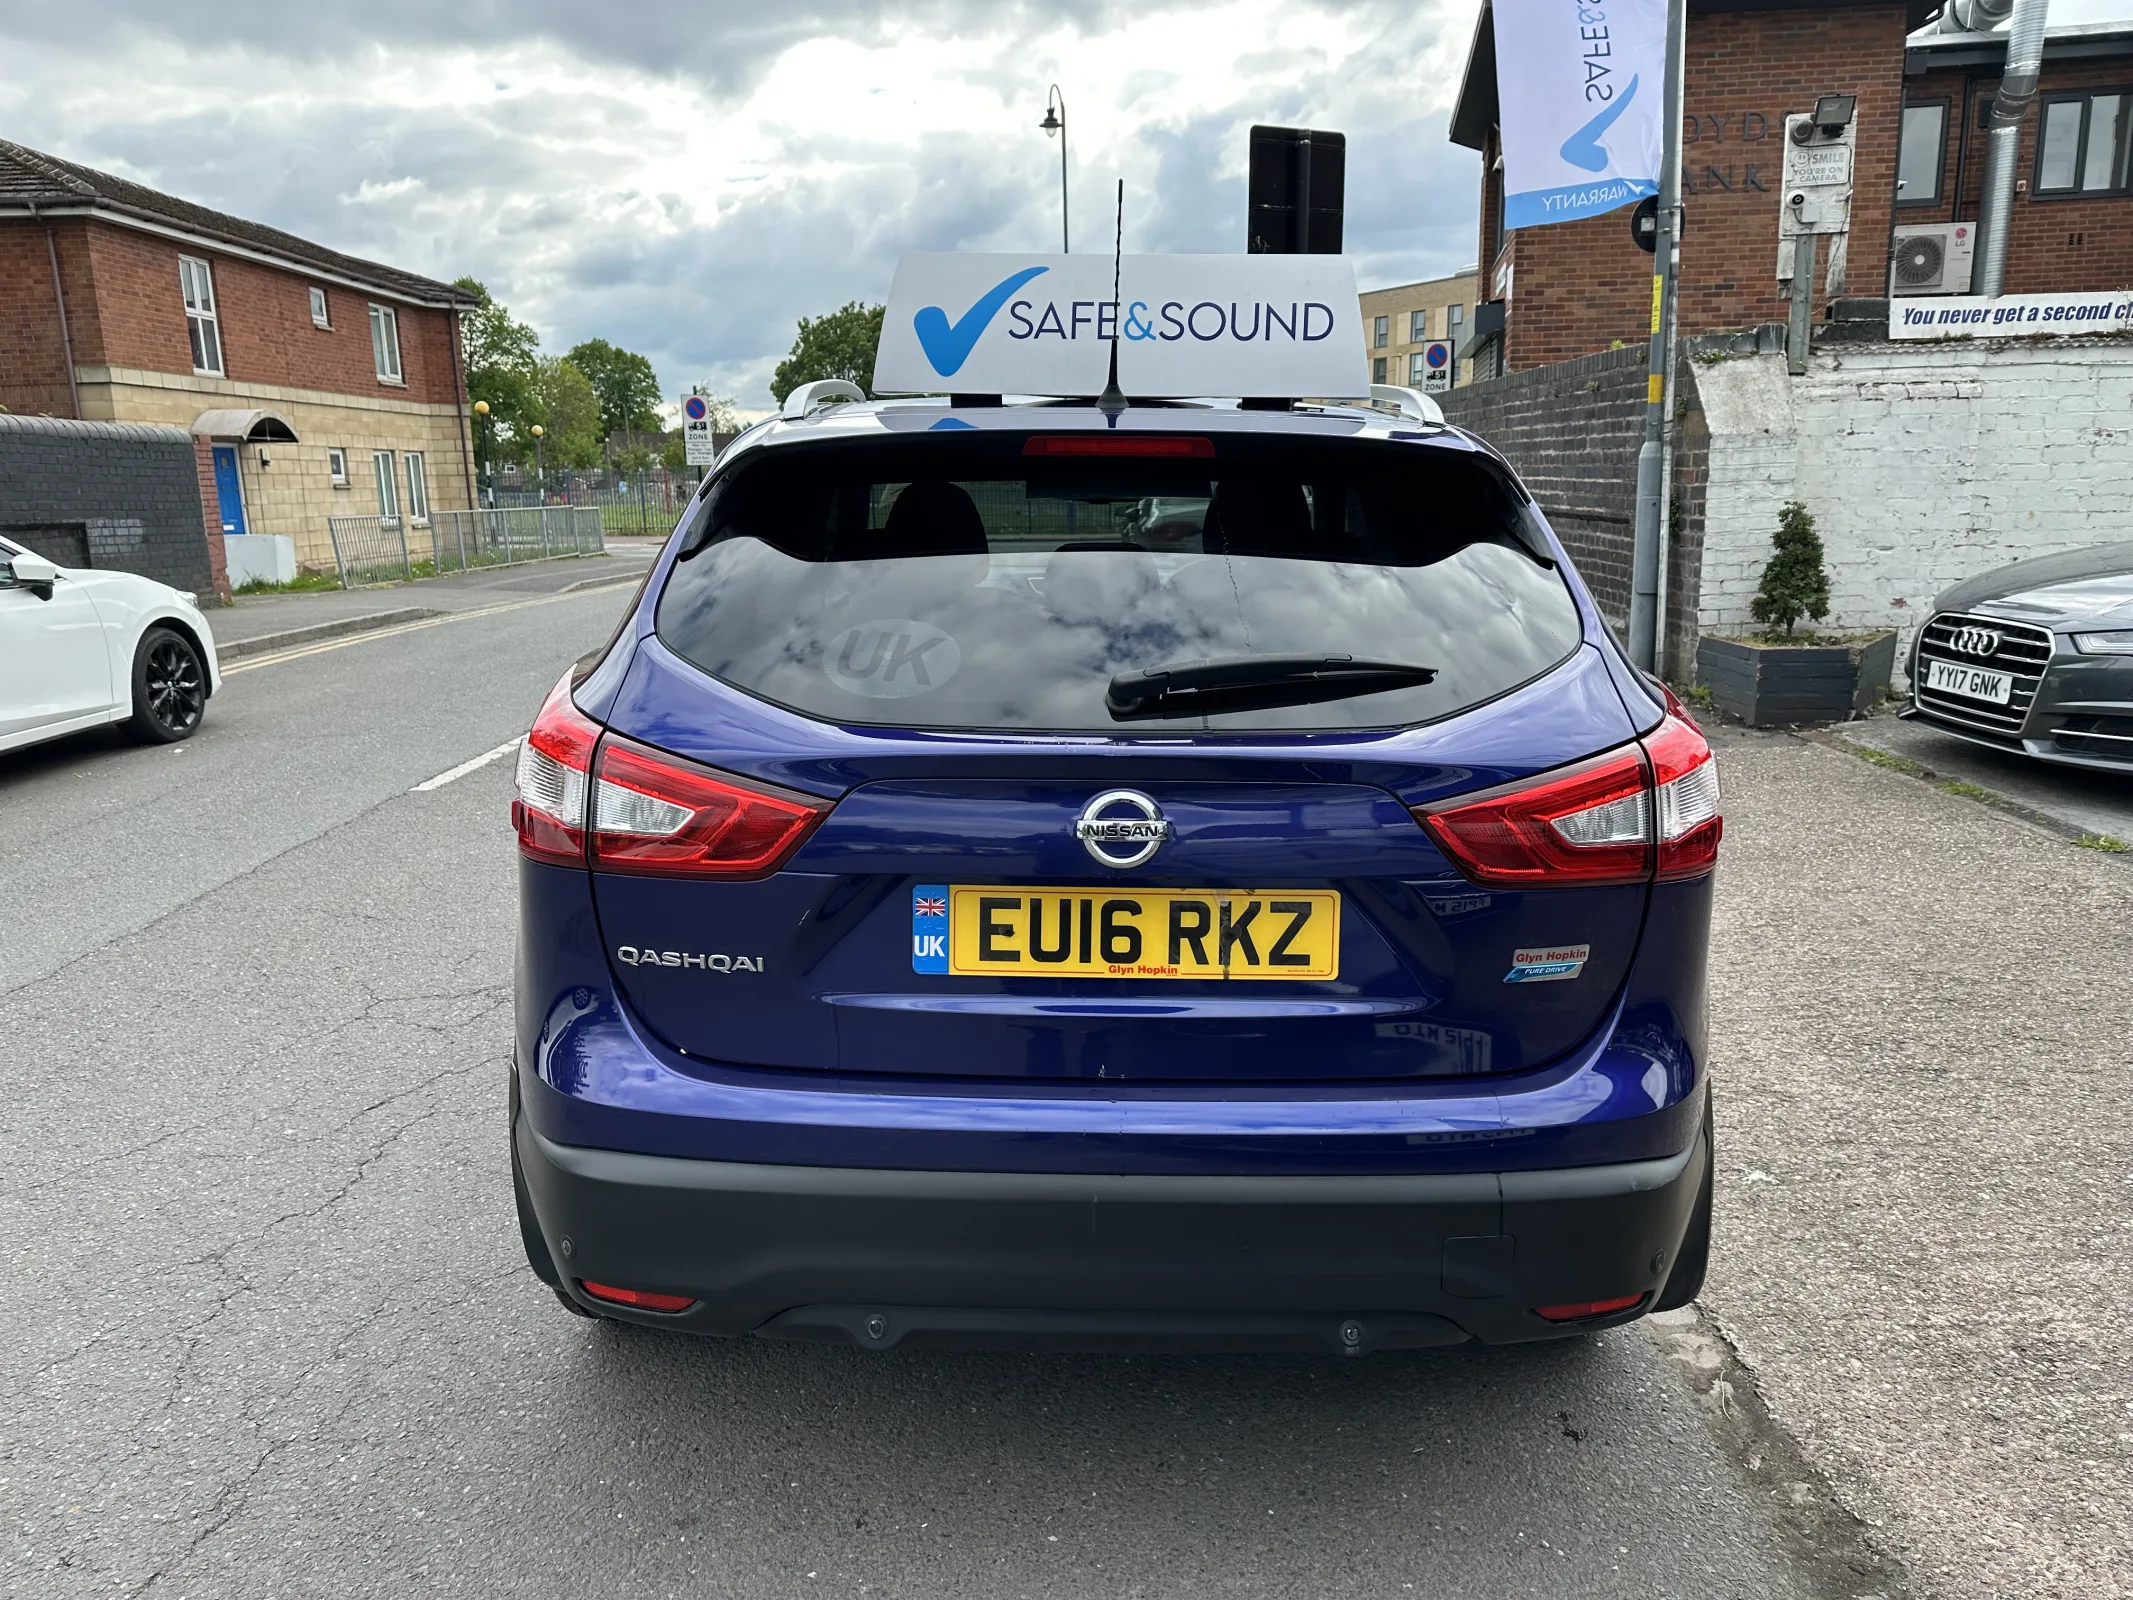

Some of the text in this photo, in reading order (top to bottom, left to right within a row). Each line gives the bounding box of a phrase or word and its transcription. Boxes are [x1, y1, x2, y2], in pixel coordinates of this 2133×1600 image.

[1812, 152, 1845, 164] SMILE
[1793, 166, 1844, 177] YOU'RE ON
[1800, 174, 1838, 183] CAMERA
[1008, 300, 1334, 342] SAFE&SOUND
[1904, 308, 1936, 325] You
[1938, 308, 1992, 324] never
[1993, 305, 2025, 325] get
[2027, 306, 2040, 321] a
[2042, 302, 2114, 321] second
[1425, 383, 1446, 391] ZONE
[837, 630, 947, 686] UK
[1937, 665, 2002, 697] YY17 GNK
[1086, 824, 1158, 837] NISSAN
[979, 896, 1313, 966] EU16 RKZ
[914, 935, 945, 957] UK
[617, 946, 764, 974] QASHQAI
[1515, 950, 1587, 963] Glyn Hopkin
[1108, 965, 1178, 976] Glyn Hopkin
